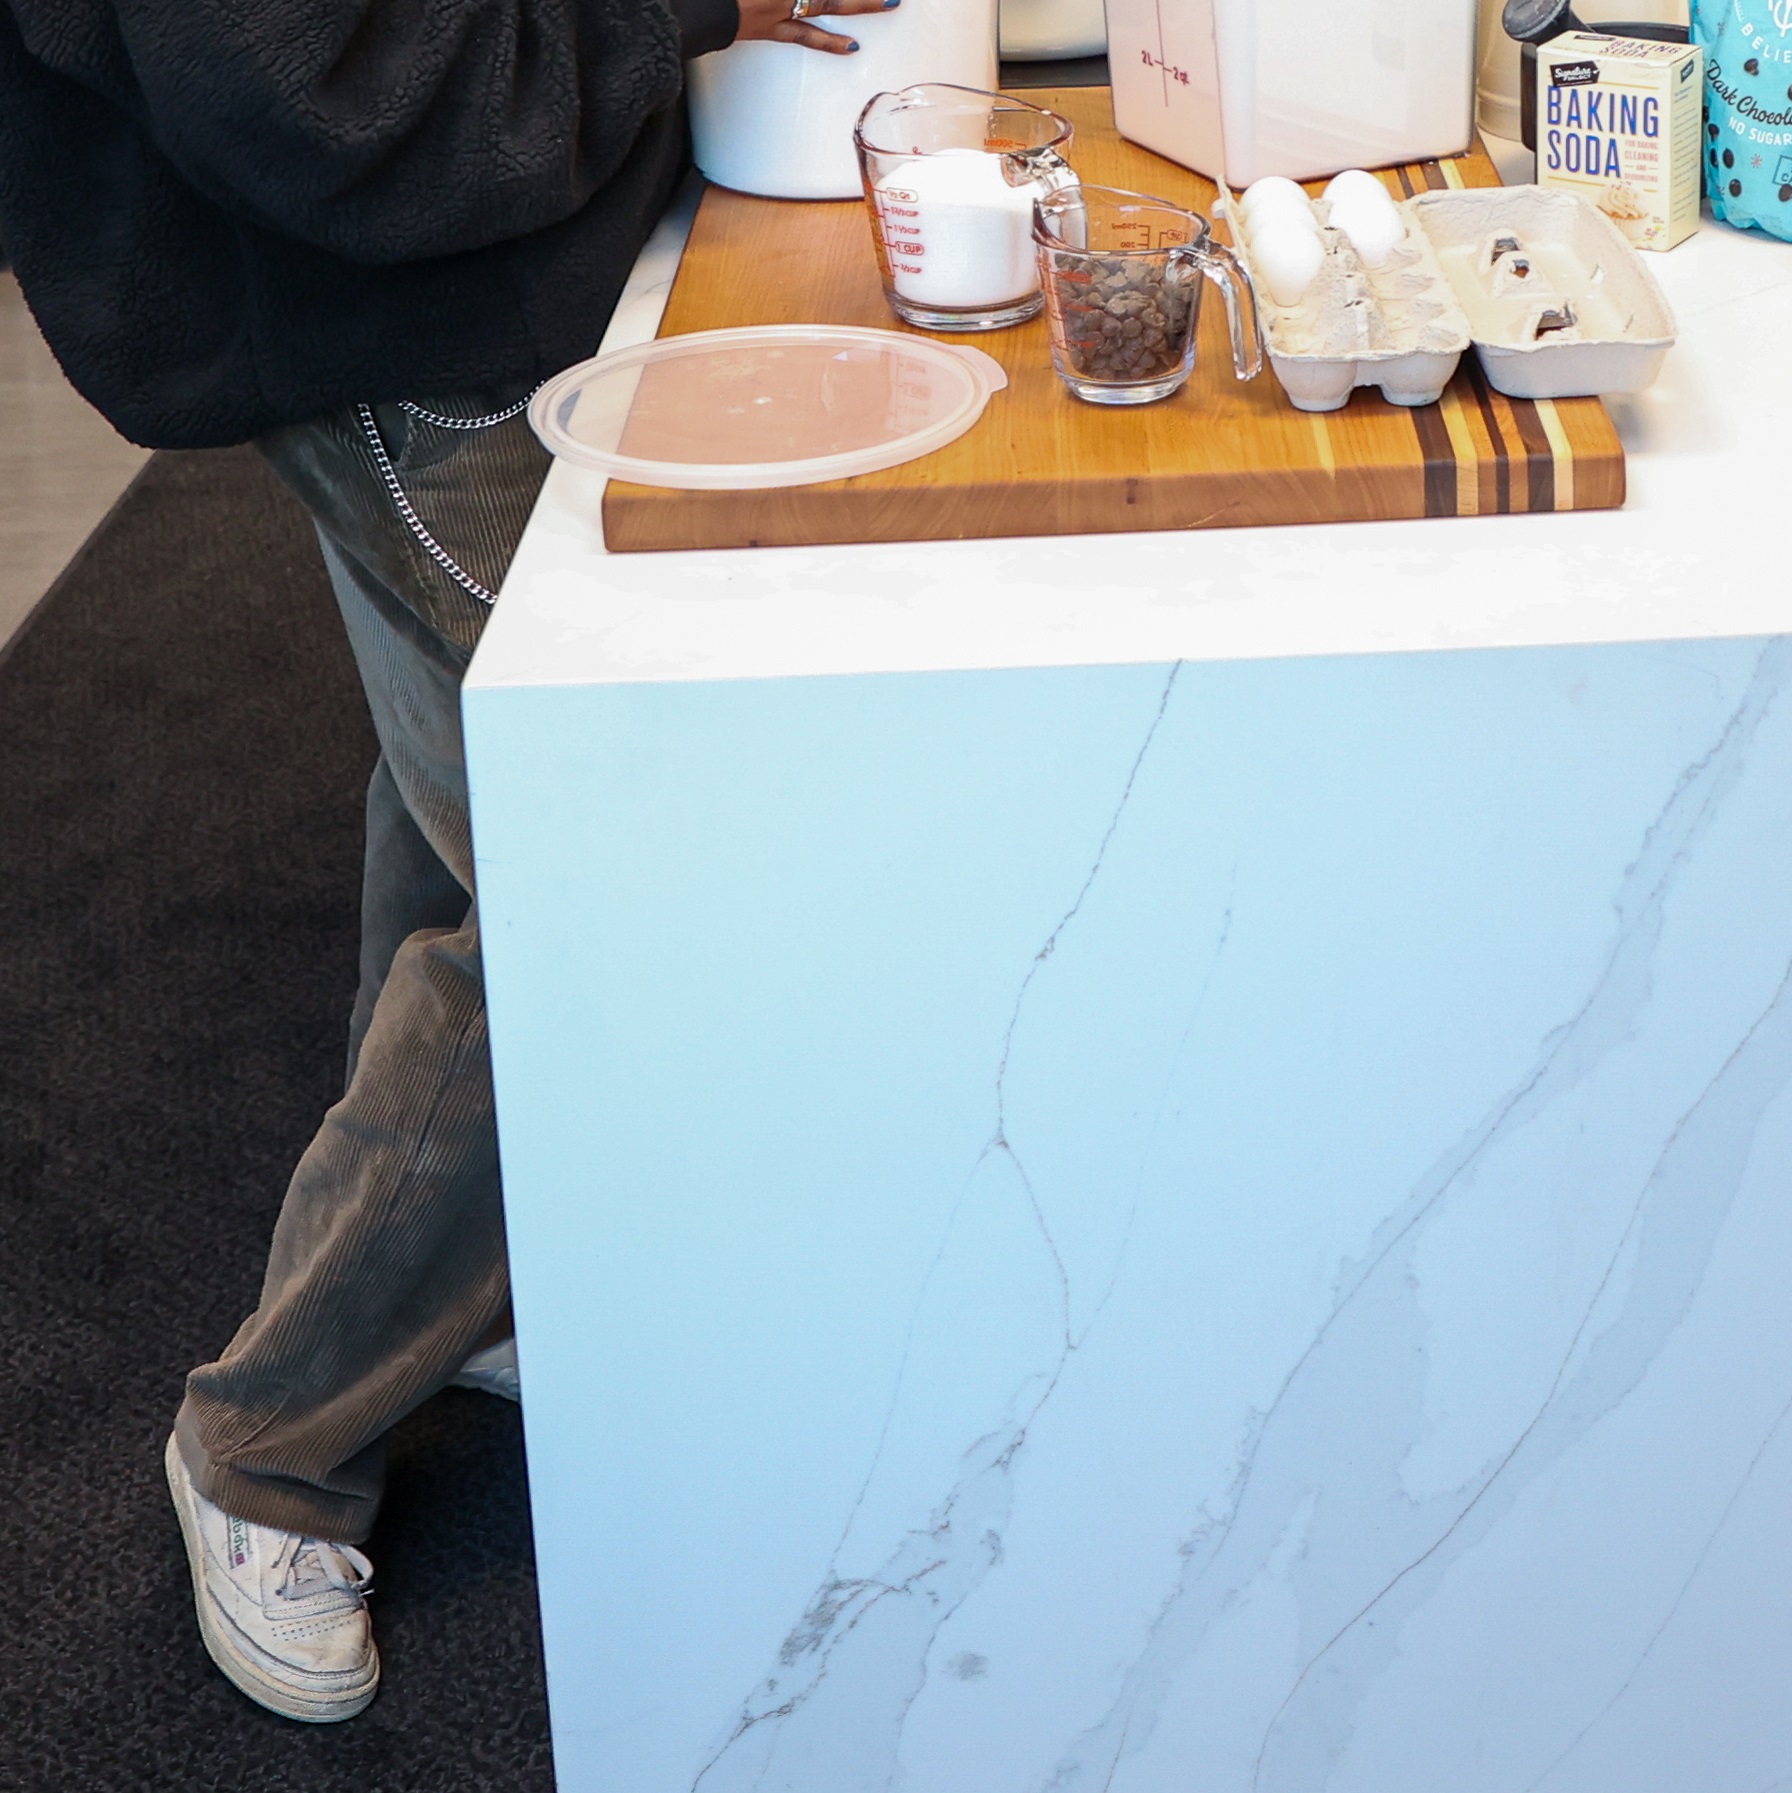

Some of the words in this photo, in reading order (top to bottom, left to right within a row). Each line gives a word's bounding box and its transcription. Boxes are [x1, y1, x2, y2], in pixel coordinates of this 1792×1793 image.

[1141, 50, 1154, 67] 2L
[1609, 40, 1683, 55] BAKING
[1706, 58, 1738, 106] Dark
[1547, 85, 1659, 138] BAKING
[1728, 116, 1745, 135] NO
[1748, 127, 1792, 146] SUGAR
[1547, 130, 1621, 178] SODA
[1625, 150, 1658, 162] CLEANING
